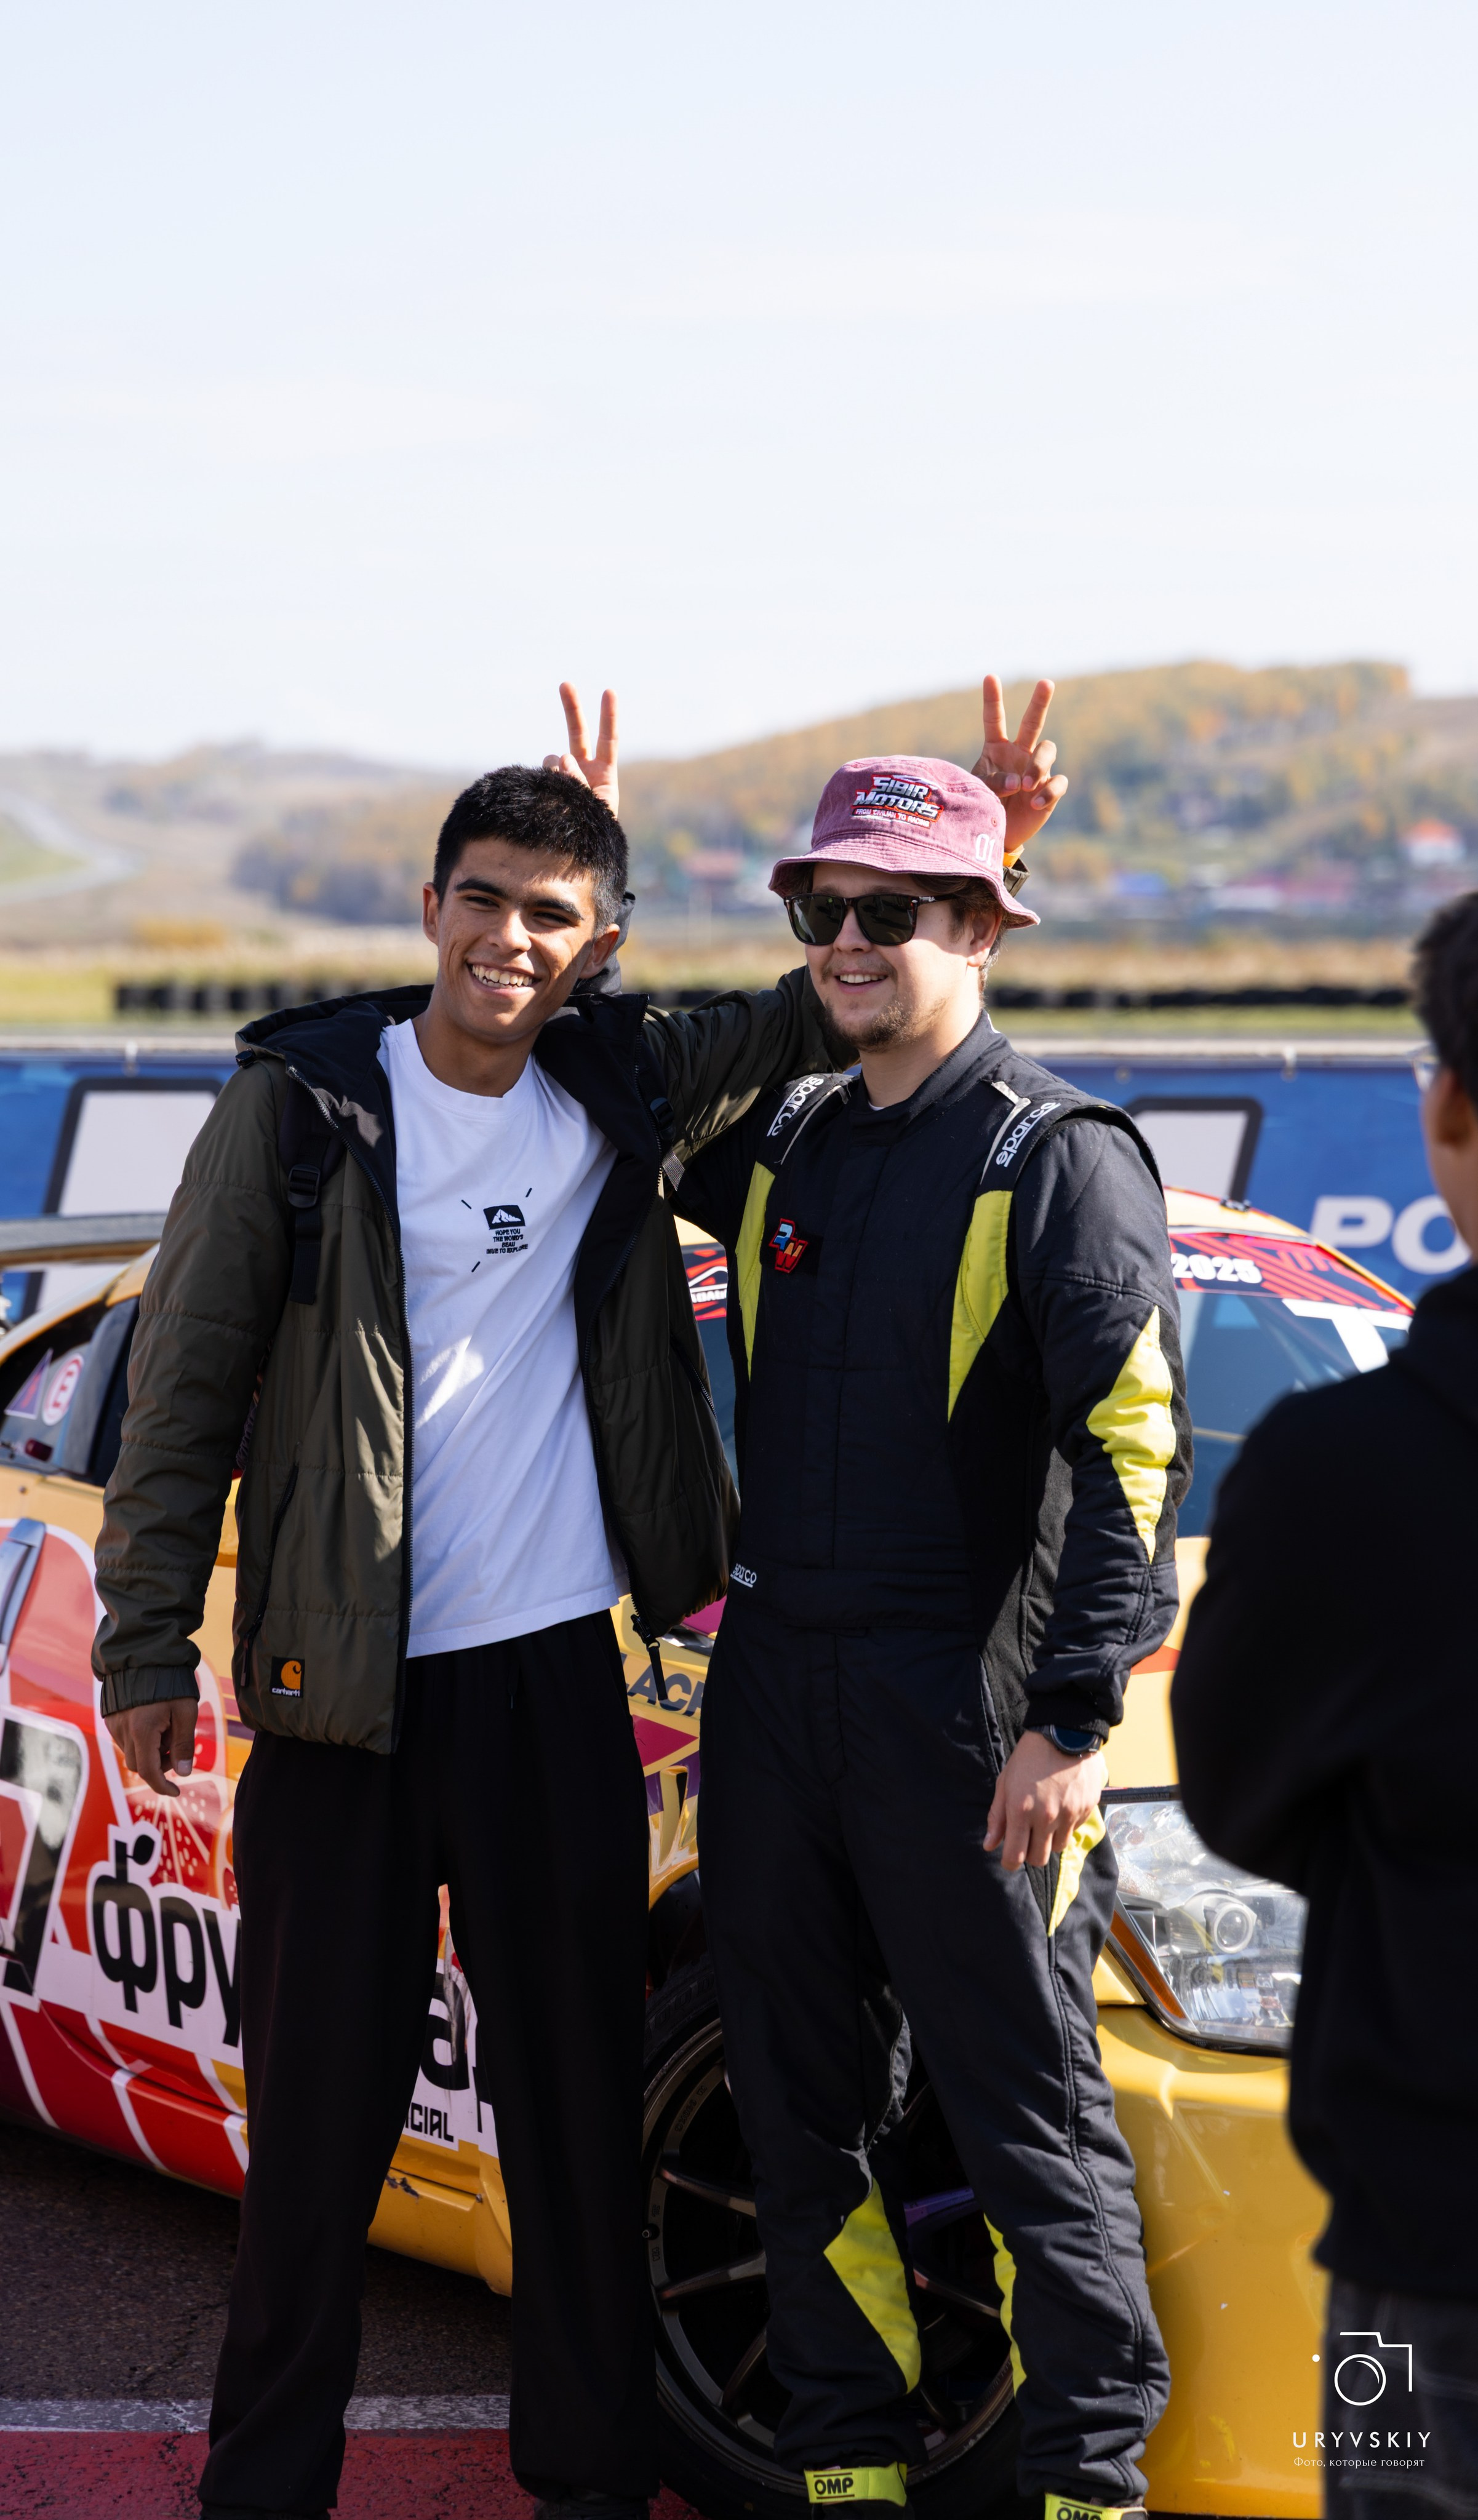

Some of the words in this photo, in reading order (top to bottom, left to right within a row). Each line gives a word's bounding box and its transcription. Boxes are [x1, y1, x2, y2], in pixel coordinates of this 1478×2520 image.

[871, 776, 929, 800] SIBIR
[853, 791, 941, 818] MOTORS
[898, 812, 907, 821] TO
[908, 815, 930, 827] RACING
[975, 834, 996, 866] 01
[1170, 1252, 1263, 1284] 2025
[814, 2476, 854, 2495] OMP
